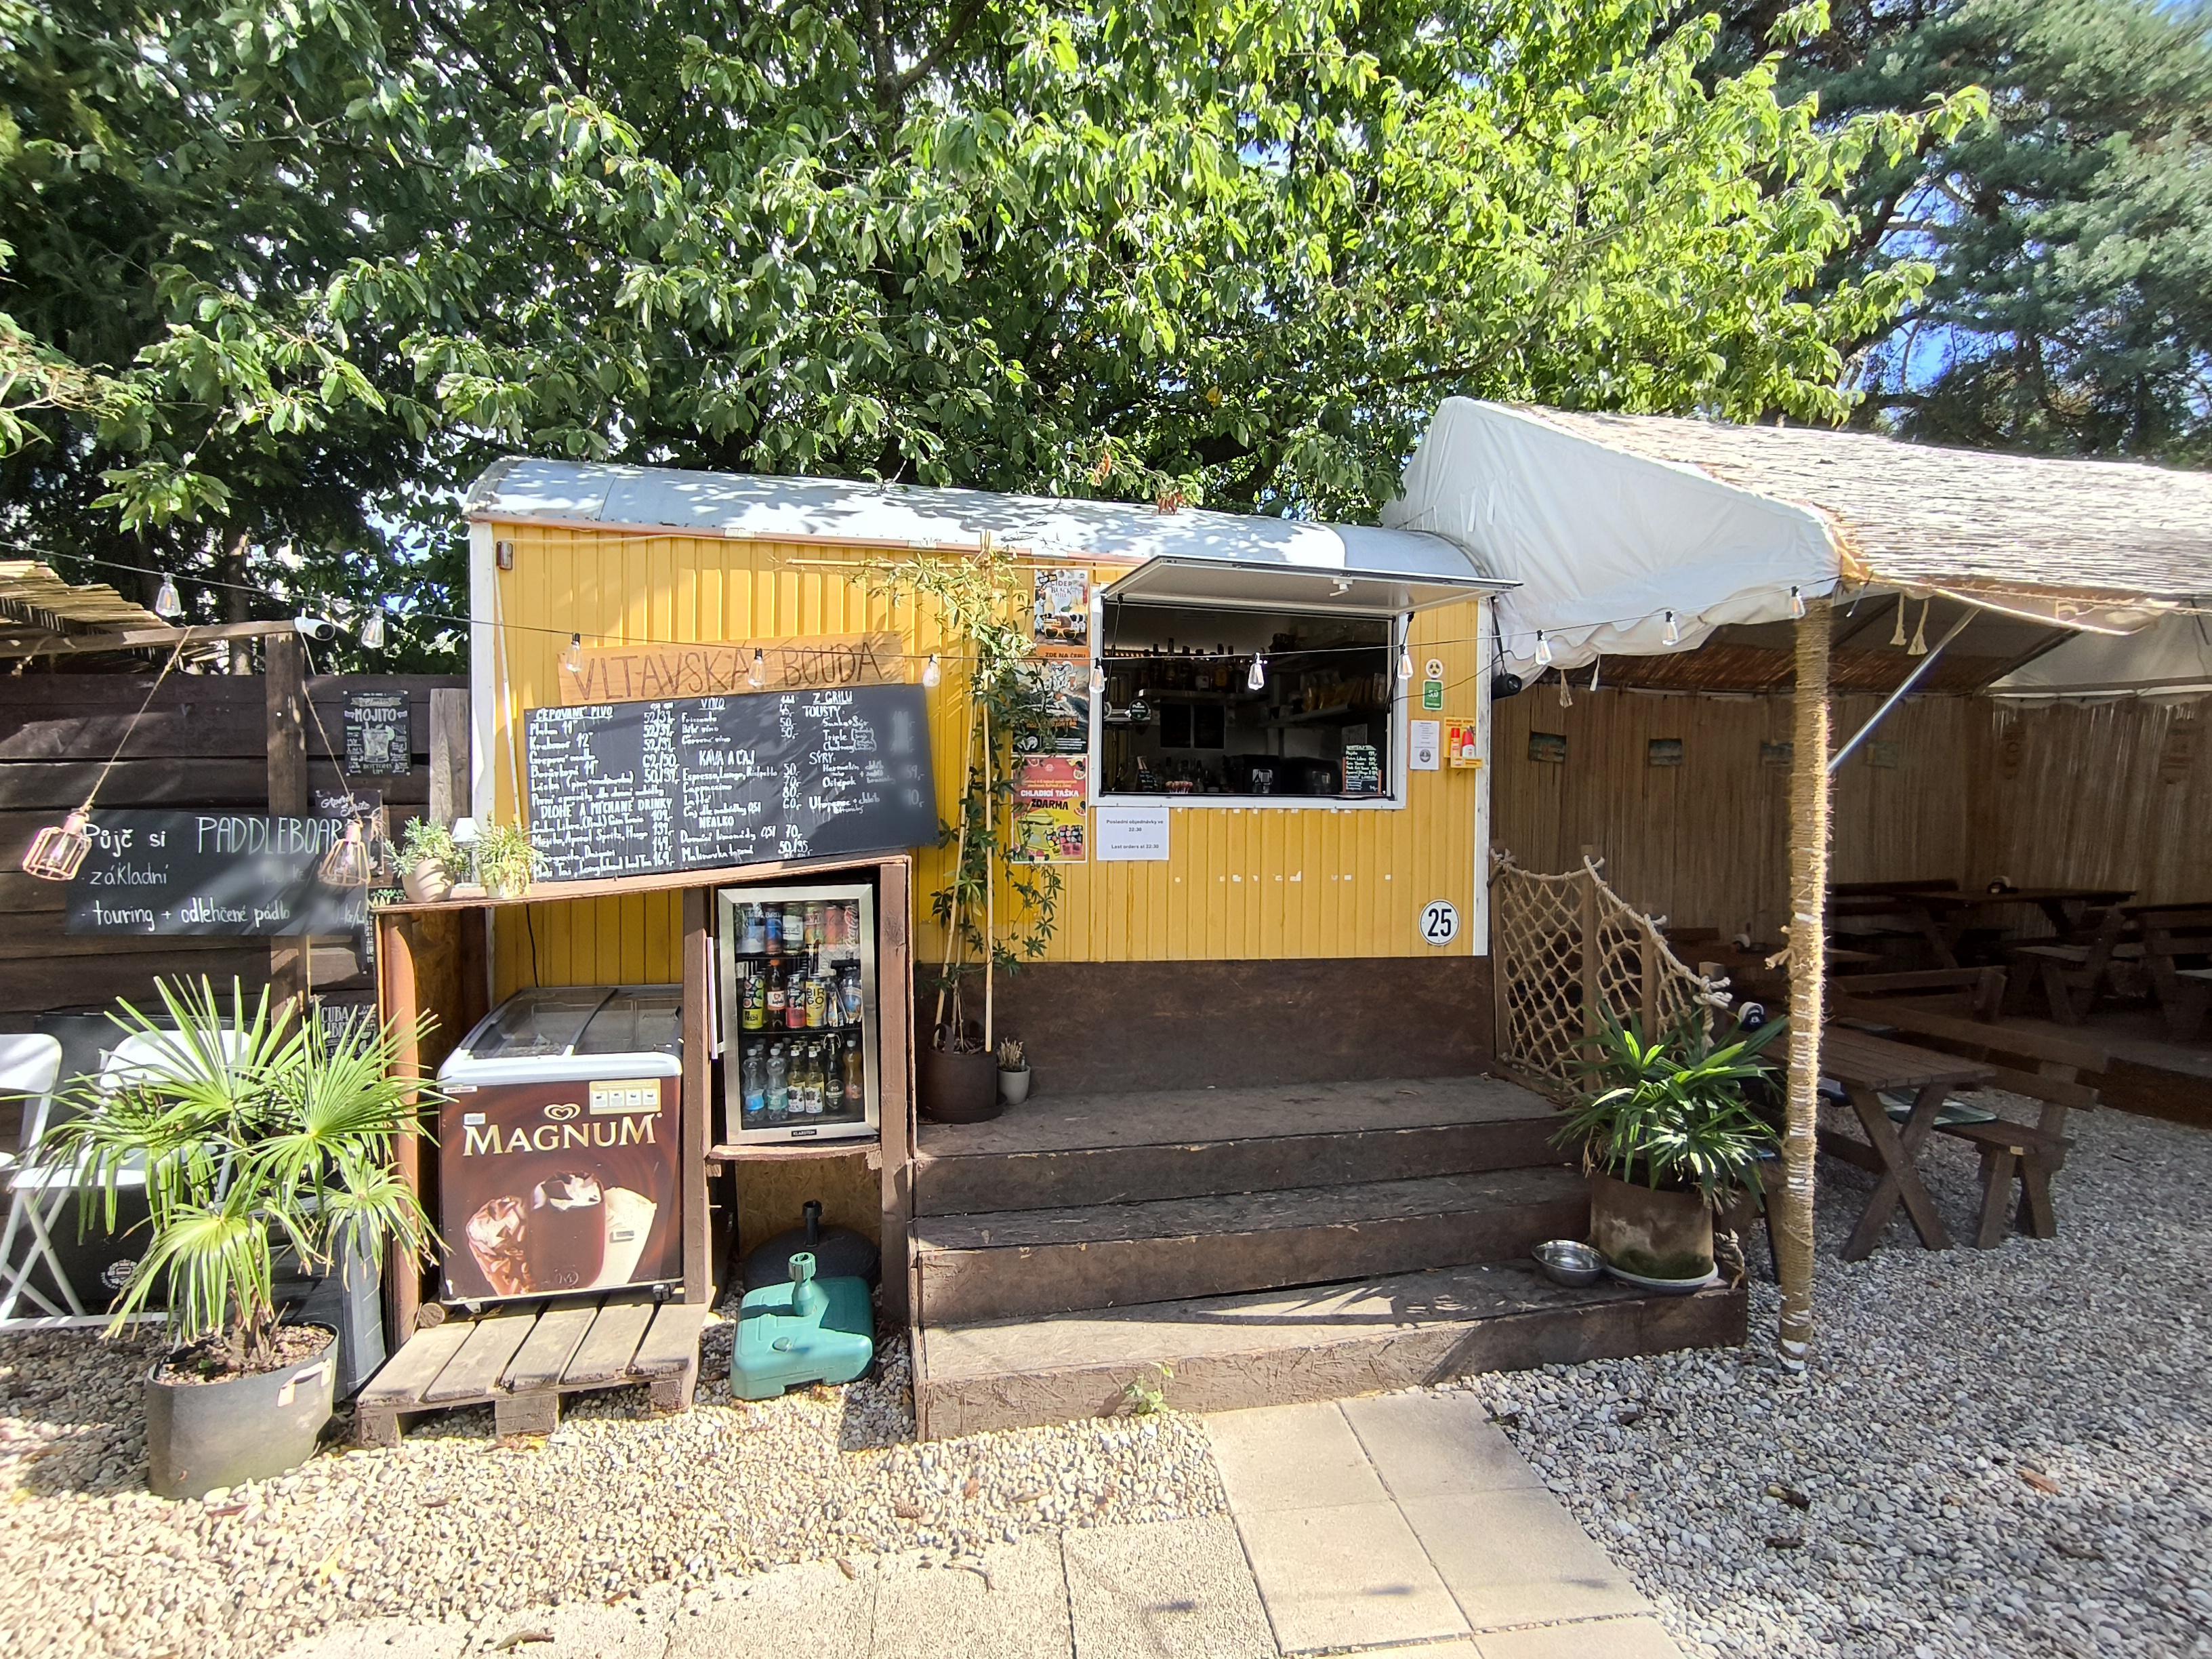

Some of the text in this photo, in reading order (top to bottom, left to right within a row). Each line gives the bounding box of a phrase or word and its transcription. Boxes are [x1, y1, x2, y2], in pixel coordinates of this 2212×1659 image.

[781, 641, 882, 687] BOUDA
[354, 708, 397, 722] MOJITO
[591, 705, 614, 716] PIVO
[1055, 788, 1080, 797] TAŠKA
[638, 798, 673, 812] DRINKY
[1031, 798, 1069, 811] ZDARMA
[699, 815, 735, 829] NEALKO
[82, 816, 350, 857] Půjč si PADDLEBOAR
[93, 897, 291, 932] touring + odlehčené pádlo
[1428, 908, 1452, 937] 25
[321, 1006, 350, 1023] CUBA
[463, 1113, 657, 1157] MAGNUM
